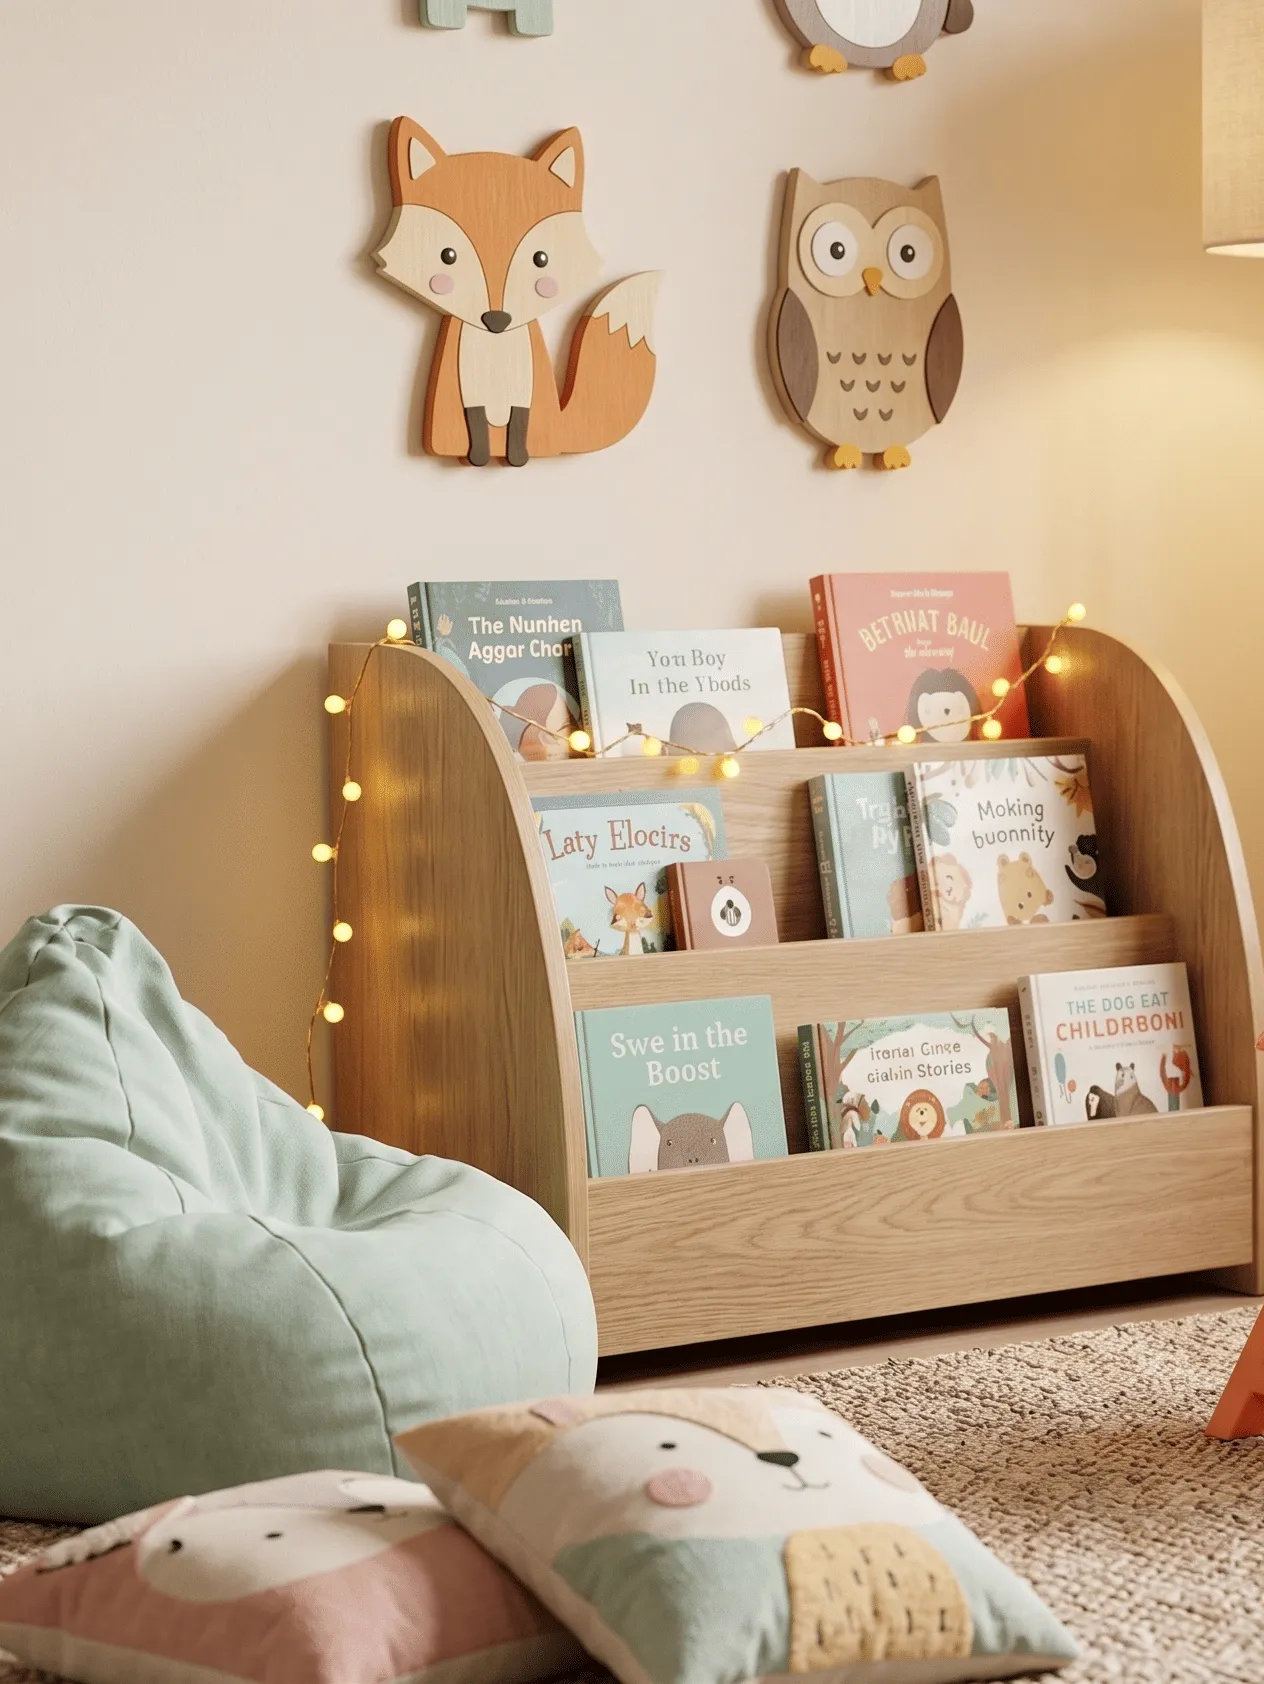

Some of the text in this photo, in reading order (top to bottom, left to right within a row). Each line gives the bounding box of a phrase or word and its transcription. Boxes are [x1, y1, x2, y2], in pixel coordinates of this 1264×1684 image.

[467, 616, 504, 635] The
[946, 611, 991, 651] BAUL
[468, 640, 525, 665] Aggar
[690, 648, 727, 671] Boy
[629, 678, 651, 695] In
[657, 677, 689, 694] the
[542, 818, 692, 861] Laty Elocirs
[971, 822, 1056, 850] buonnity
[1067, 991, 1170, 1016] THE DOG EAT
[610, 1020, 749, 1059] Swe in the
[1055, 1011, 1185, 1042] CHILDRBONI
[645, 1057, 722, 1087] Boost
[916, 1060, 972, 1079] Stories
